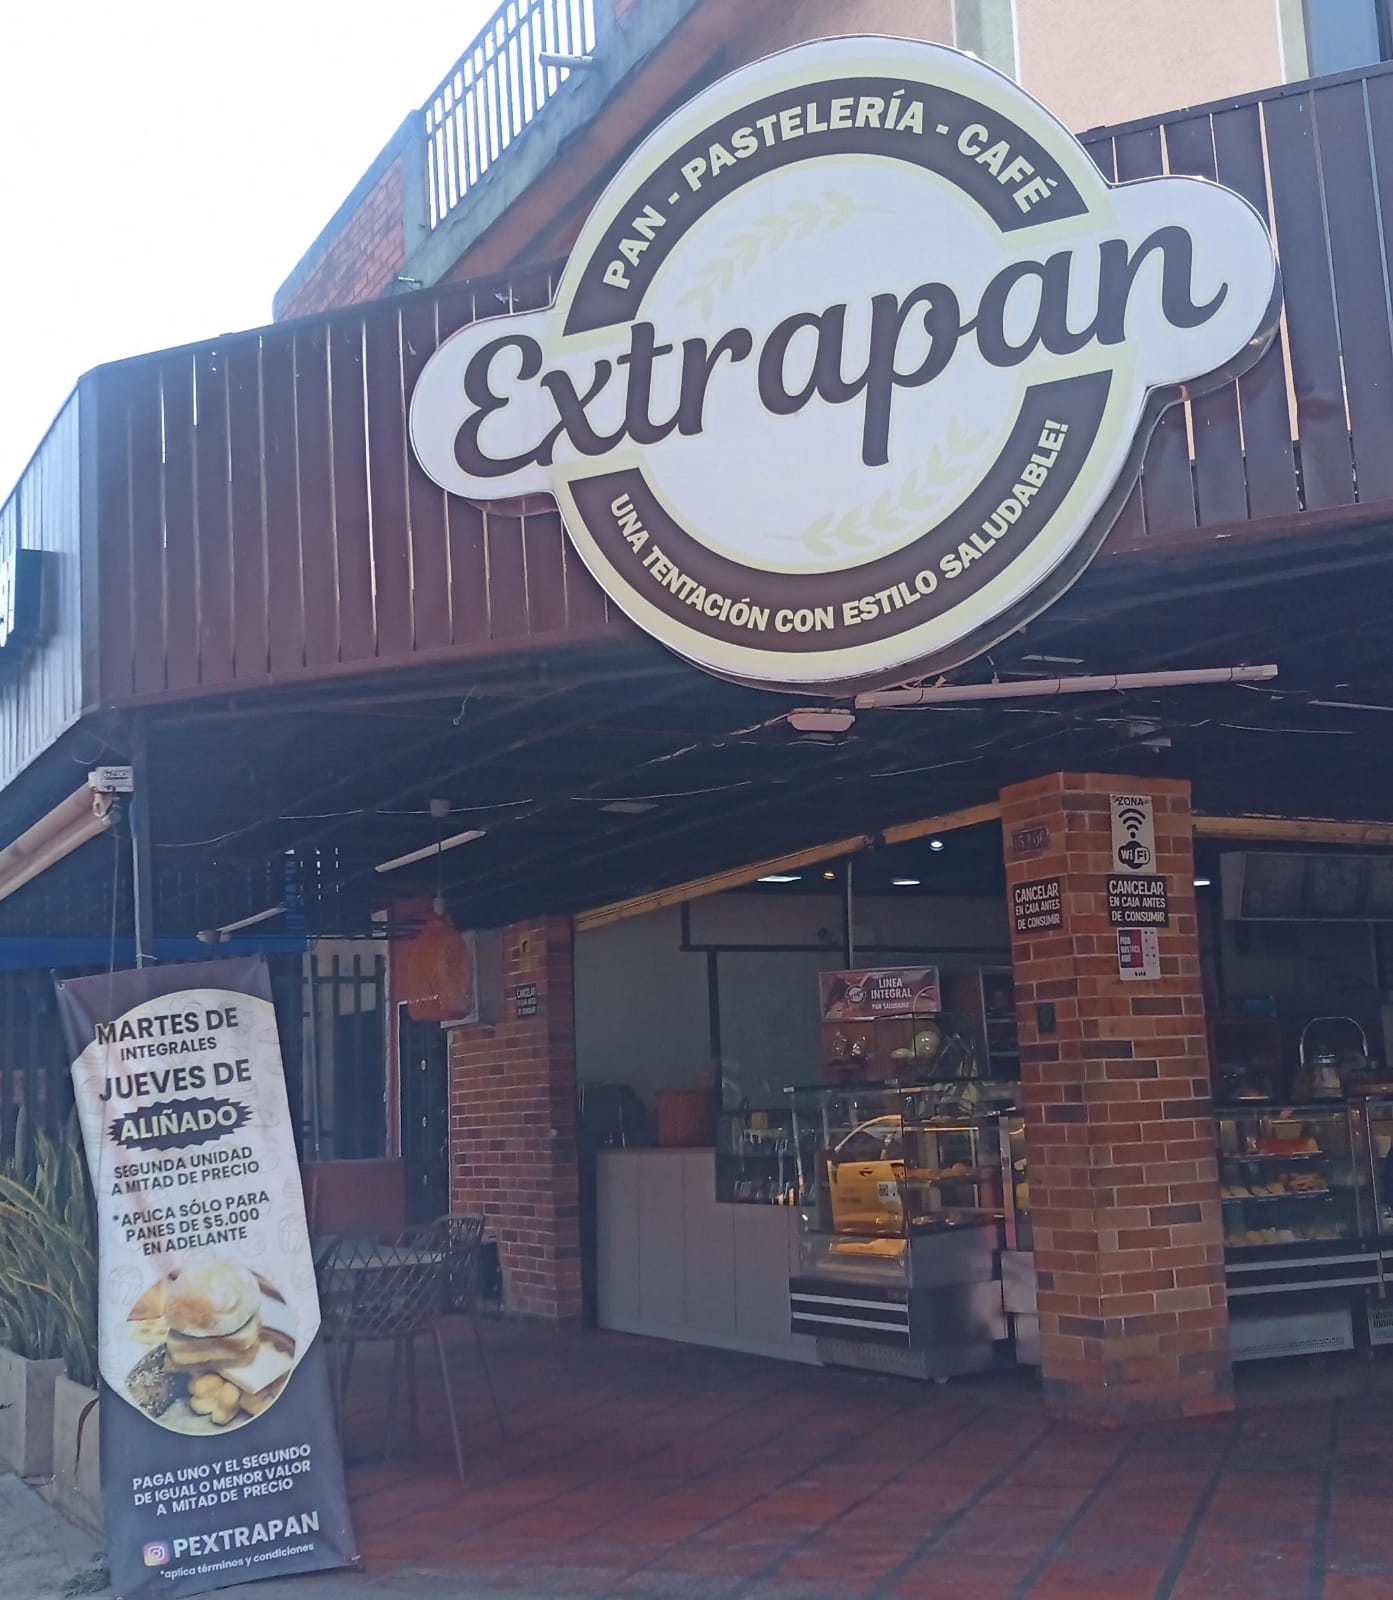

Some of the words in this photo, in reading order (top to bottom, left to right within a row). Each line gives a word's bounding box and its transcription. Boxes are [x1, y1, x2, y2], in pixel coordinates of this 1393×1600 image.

[602, 204, 667, 289] PAN
[667, 192, 681, 205] -
[680, 89, 924, 192] PASTELERÍA
[935, 124, 950, 135] -
[957, 123, 1059, 214] CAFÉ
[452, 223, 1229, 478] Extrapan
[611, 493, 650, 554] UNA
[642, 545, 770, 632] TENTACIÓN
[774, 606, 834, 633] CON
[842, 570, 938, 626] ESTILO
[939, 419, 1069, 580] SALUDABLE!
[1118, 796, 1144, 806] ZONA
[1015, 882, 1059, 903] CANCELAR
[1109, 880, 1165, 896] CANCELAR
[1110, 896, 1120, 907] EN
[1142, 898, 1166, 908] ANTES
[1015, 905, 1024, 916] EN
[1041, 899, 1061, 911] ANTES
[1017, 918, 1026, 930] DE
[1027, 914, 1061, 927] CONSUMIR
[1112, 911, 1122, 921] DE
[1124, 911, 1165, 922] CONSUMIR
[871, 988, 912, 999] INTEGRAL
[878, 977, 903, 989] LINEA
[97, 1012, 200, 1045] MARTES
[206, 1007, 239, 1031] DE
[121, 1037, 217, 1061] INTEGRALES
[99, 1065, 206, 1101] JUEVES
[214, 1058, 251, 1086] DE
[120, 1105, 238, 1141] ALIÑADO
[112, 1183, 123, 1196] A
[125, 1175, 174, 1194] MITAD
[178, 1171, 198, 1186] DE
[202, 1160, 260, 1182] PRECIO
[114, 1158, 187, 1180] SEGUNDA
[190, 1146, 253, 1167] UNIDAD
[179, 1198, 222, 1218] SÓLO
[225, 1190, 270, 1210] PARA
[126, 1222, 175, 1242] PANES
[179, 1218, 200, 1233] DE
[203, 1207, 259, 1230] $5.000
[143, 1240, 161, 1256] EN
[165, 1226, 248, 1252] ADELANTE
[132, 1471, 175, 1490] PAGA
[177, 1465, 209, 1482] UNO
[211, 1462, 222, 1475] Y
[225, 1459, 240, 1473] EL
[242, 1444, 311, 1469] SEGUNDO
[134, 1493, 151, 1506] DE
[155, 1484, 196, 1502] IGUAL
[199, 1481, 211, 1493] O
[212, 1471, 263, 1490] MENOR
[263, 1460, 311, 1480] VALOR
[156, 1503, 167, 1516] A
[172, 1493, 217, 1513] MITAD
[220, 1489, 238, 1504] DE
[243, 1478, 294, 1498] PRECIO
[173, 1510, 320, 1559] PEXTRAPAN
[197, 1557, 244, 1574] términos
[244, 1556, 252, 1567] y
[253, 1543, 315, 1563] condiciones
